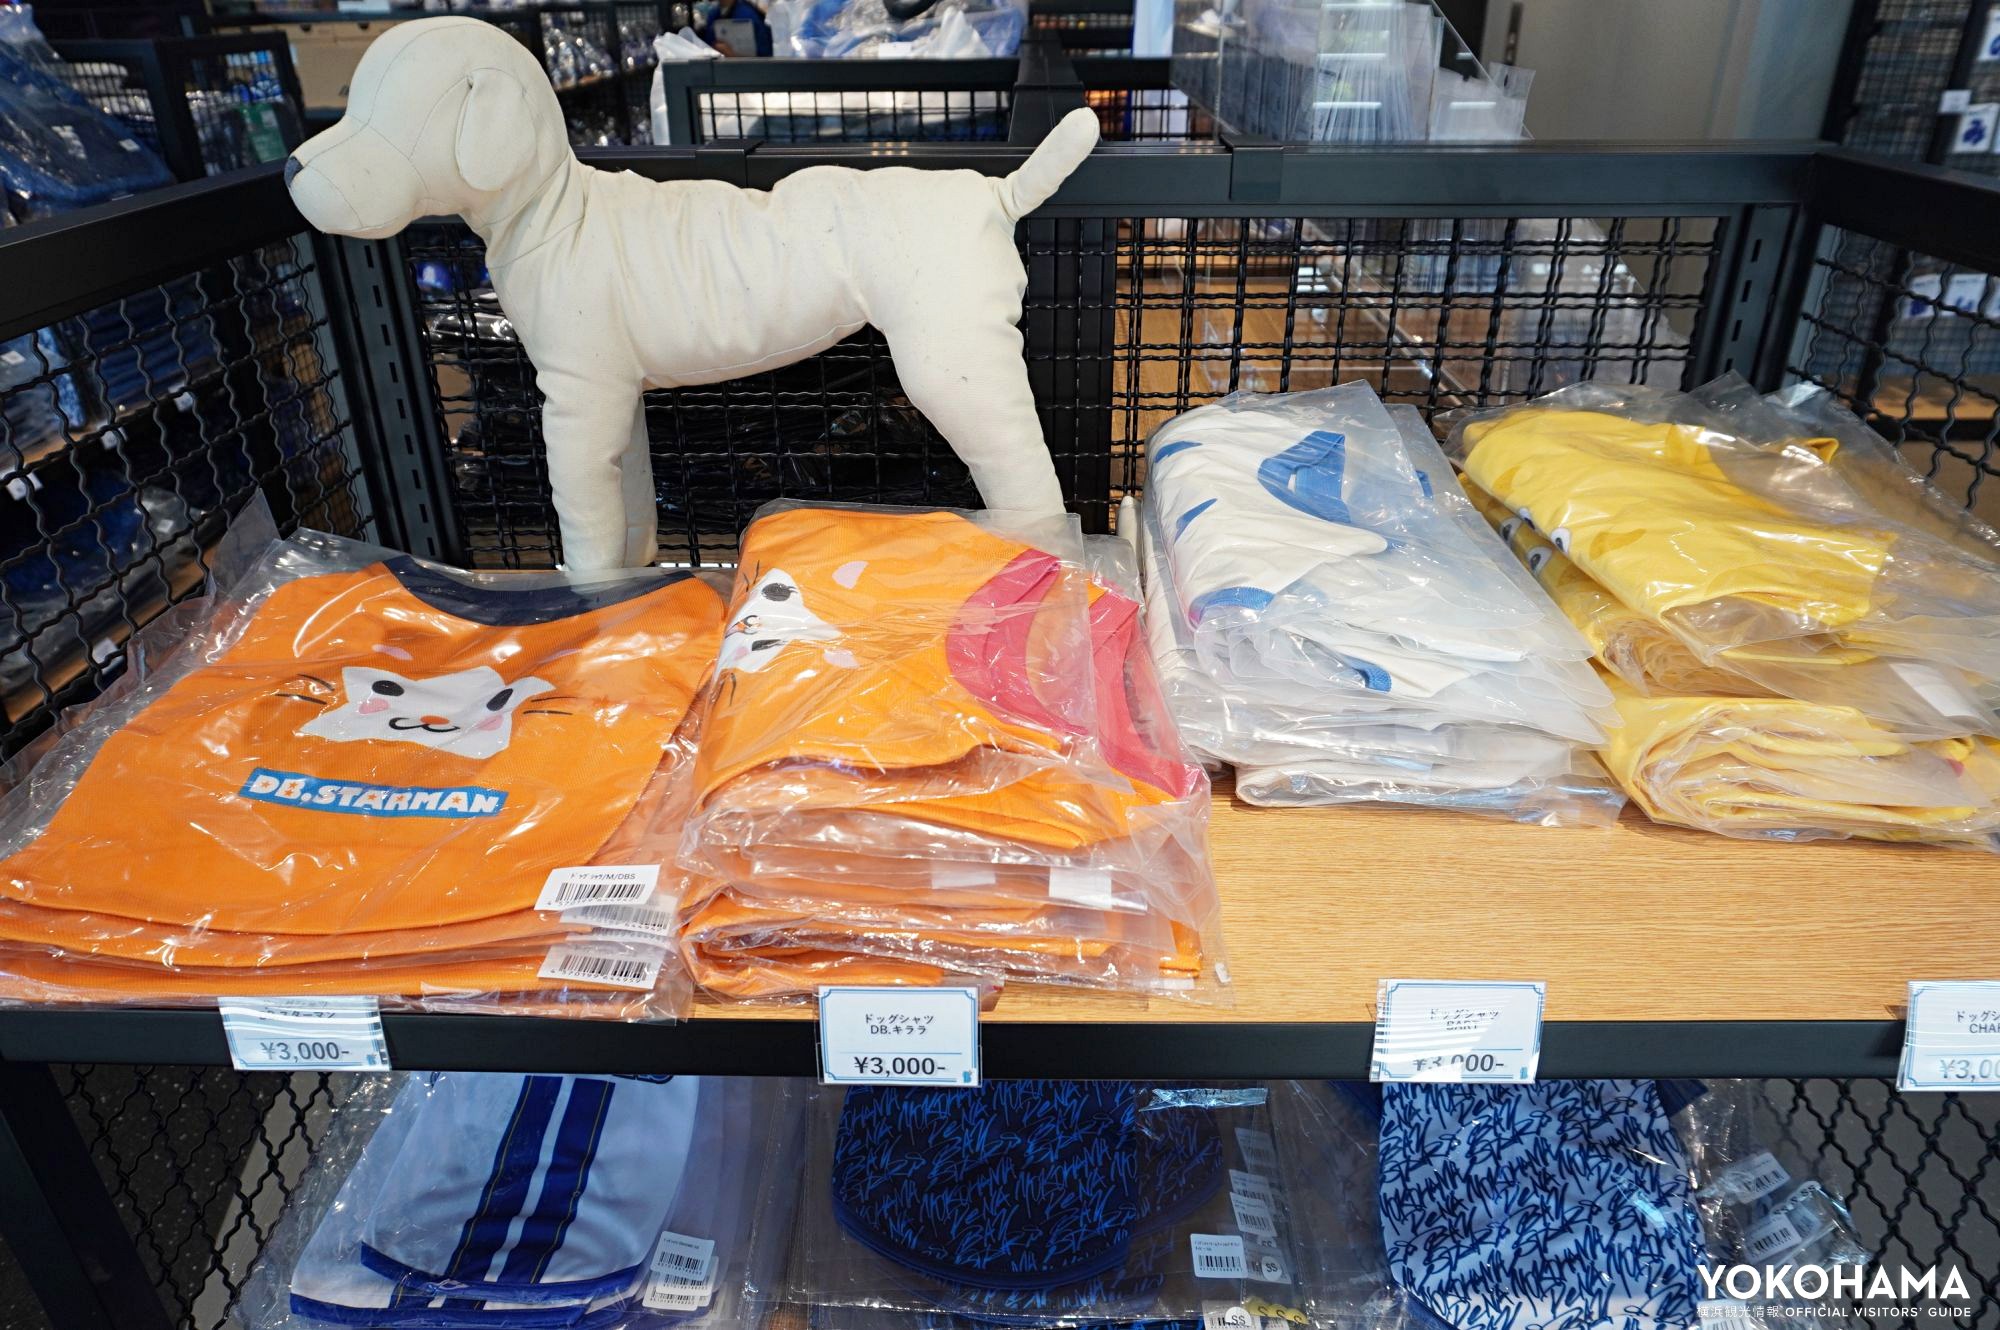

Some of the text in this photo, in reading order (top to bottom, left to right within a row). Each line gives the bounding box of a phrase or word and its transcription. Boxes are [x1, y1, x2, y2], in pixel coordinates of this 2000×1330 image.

[249, 775, 500, 813] DB.STARMAN
[865, 1013, 934, 1024] ドッグシャツ
[870, 1025, 927, 1035] DB.キララ
[261, 1042, 349, 1063] ¥3,000-
[854, 1057, 946, 1078] ¥3,000-
[1265, 1263, 1278, 1272] SS
[1232, 1315, 1246, 1325] SS
